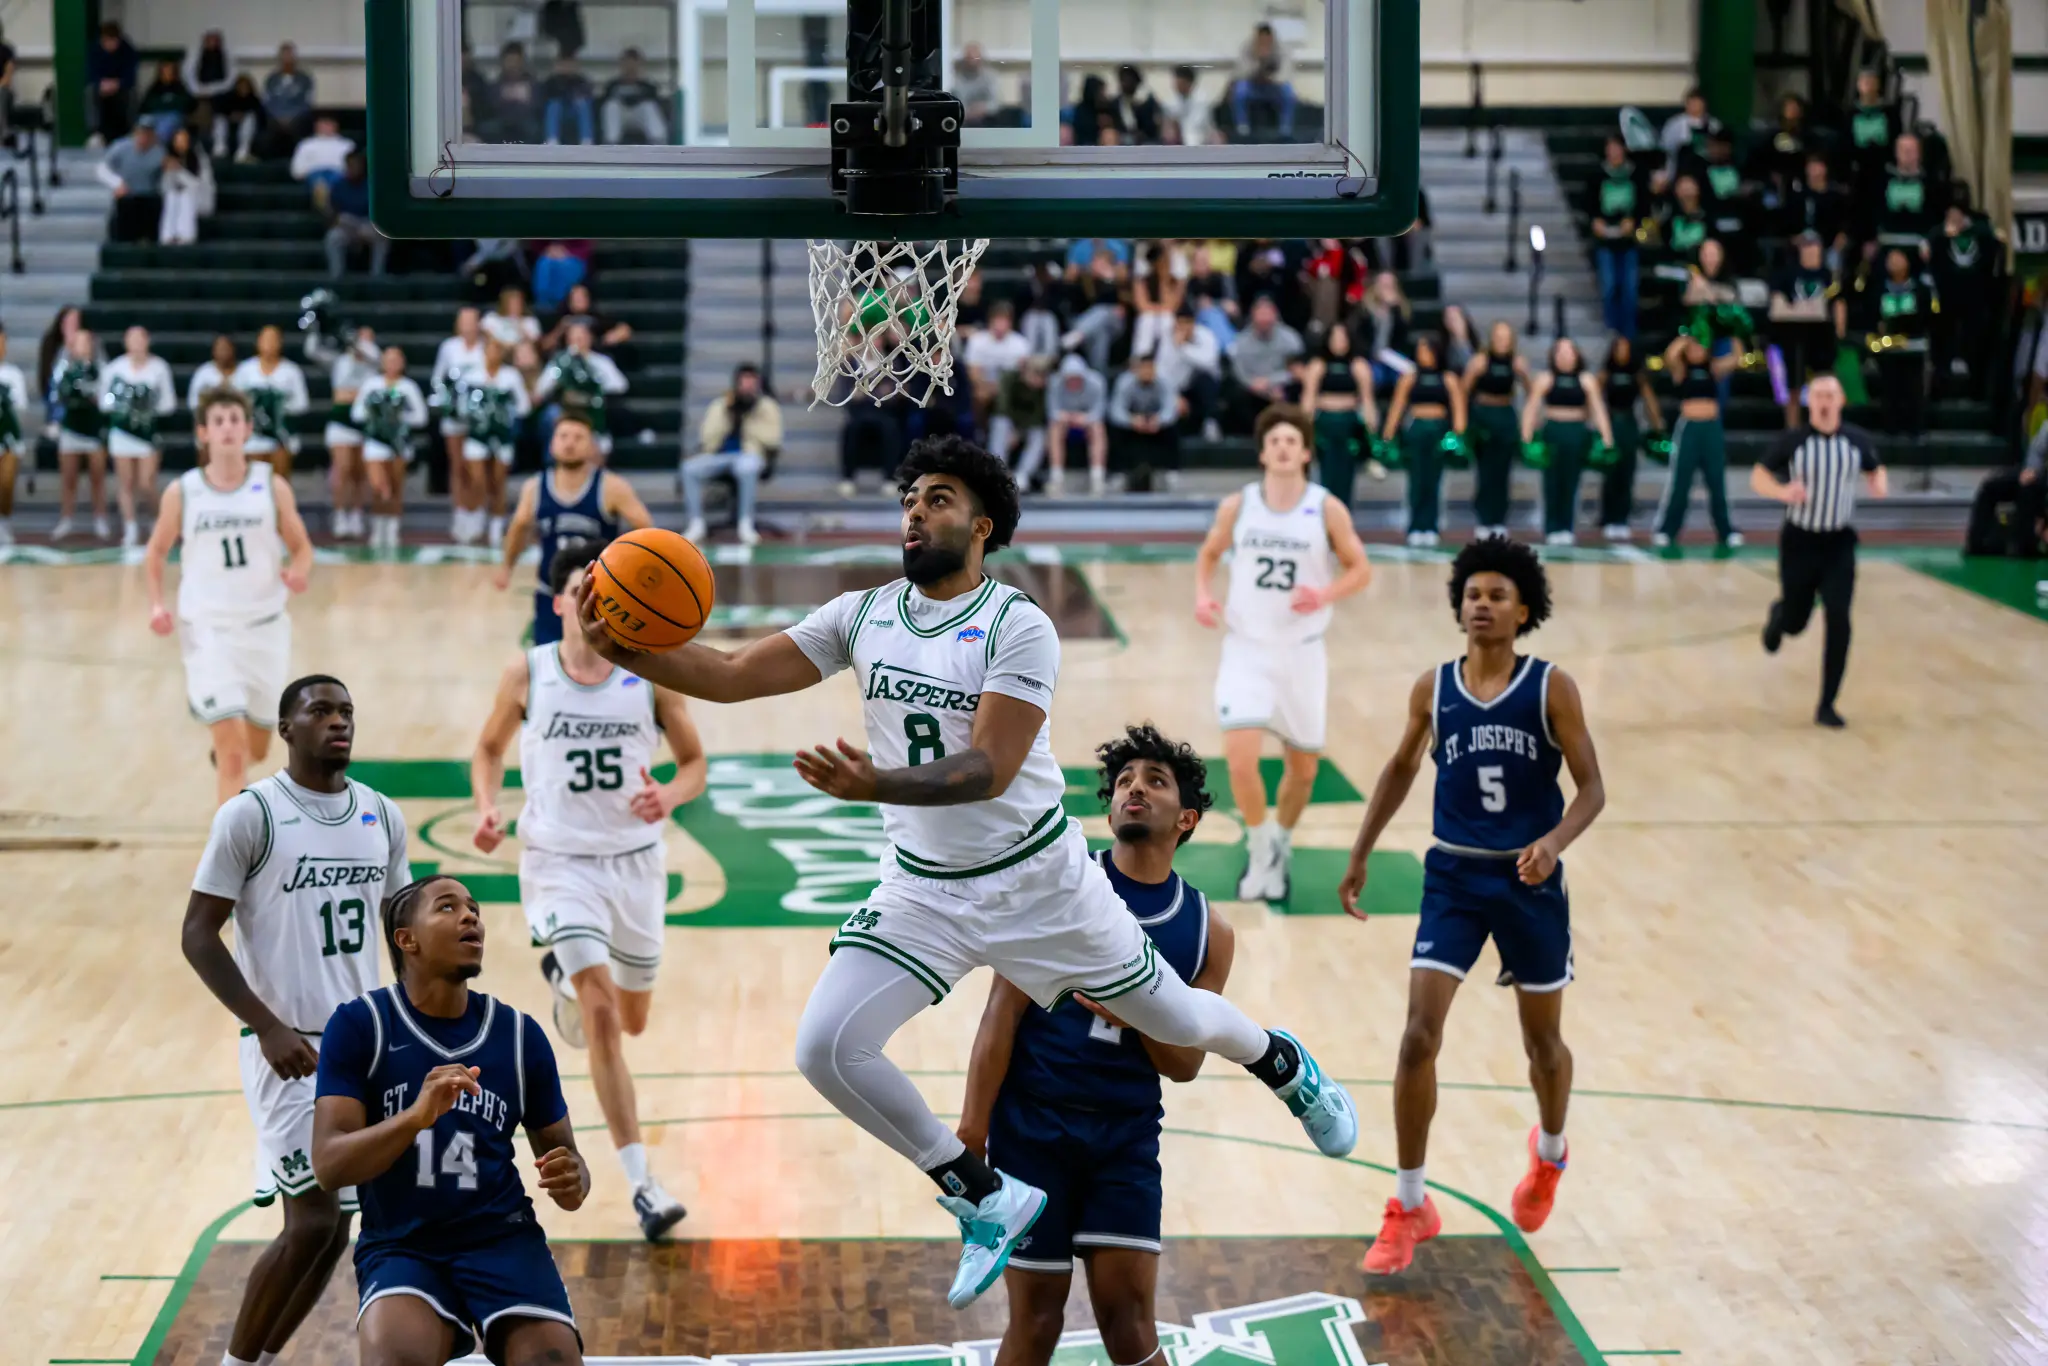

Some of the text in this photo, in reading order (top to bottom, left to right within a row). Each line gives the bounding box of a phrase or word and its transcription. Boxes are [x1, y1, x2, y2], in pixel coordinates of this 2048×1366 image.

[222, 537, 247, 568] 11
[1256, 556, 1296, 591] 23
[869, 619, 895, 628] capelli
[865, 670, 982, 712] JASPERS
[1017, 675, 1043, 690] capelli
[543, 714, 641, 740] JASPERS
[904, 713, 946, 766] 8
[1468, 724, 1538, 760] JOSEPH'S
[565, 746, 624, 792] 35
[1477, 765, 1507, 812] 5
[282, 862, 388, 893] JASPERS
[319, 898, 366, 957] 13
[414, 1128, 478, 1190] 14
